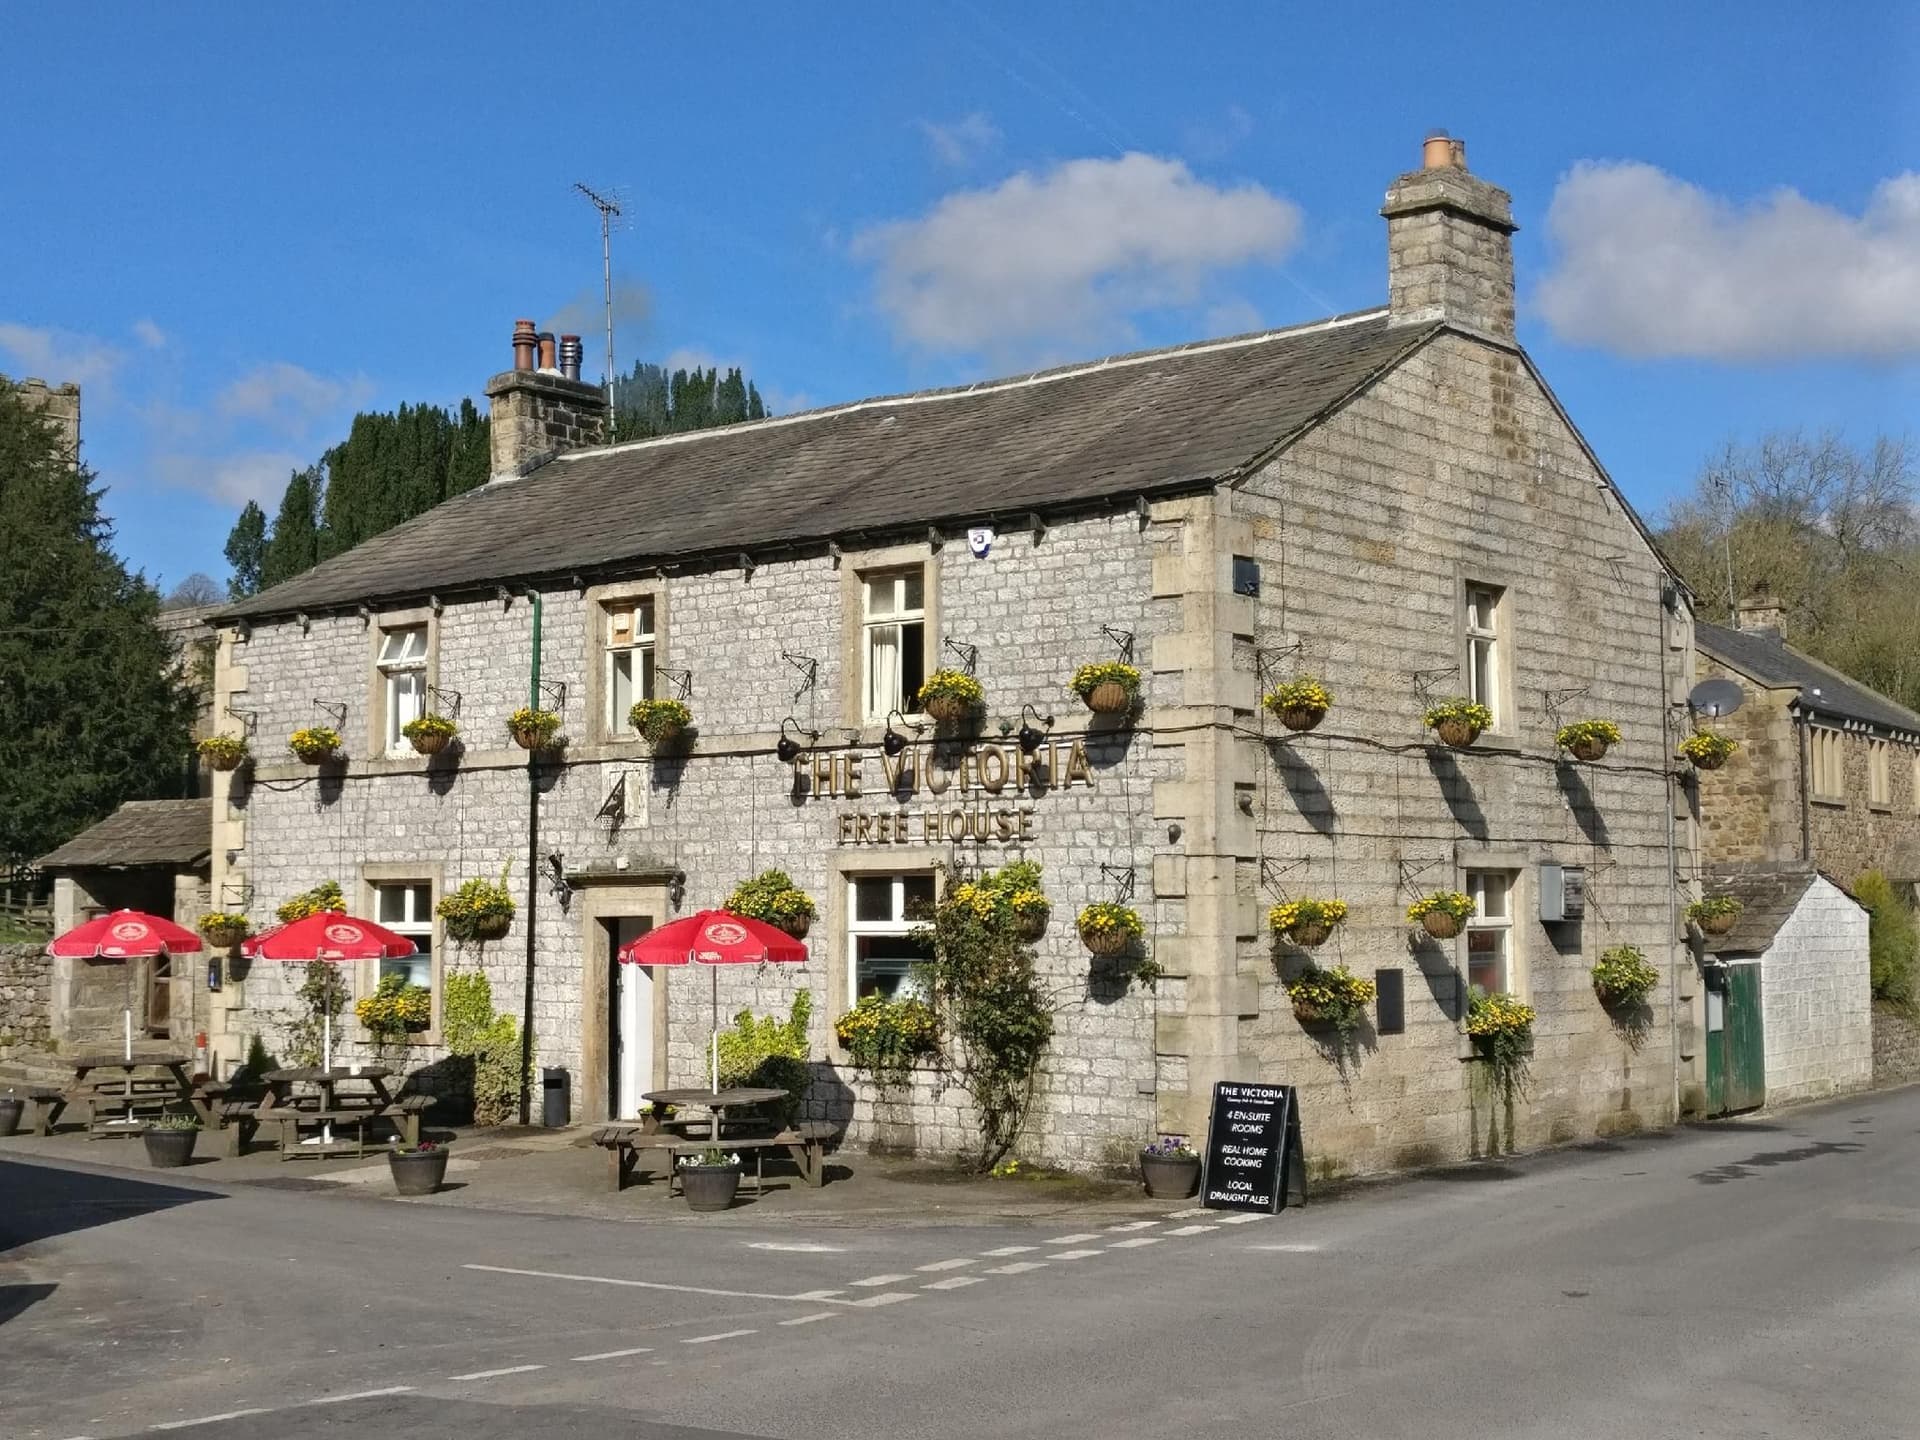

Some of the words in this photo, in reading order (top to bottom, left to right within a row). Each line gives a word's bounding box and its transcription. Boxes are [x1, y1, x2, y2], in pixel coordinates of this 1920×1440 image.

[794, 752, 862, 799] THE
[881, 740, 1095, 795] VICTORIA
[839, 810, 909, 846] FREE
[925, 807, 1034, 844] HOUSE
[1220, 1086, 1239, 1096] THE
[1241, 1087, 1284, 1099] VICTORIA
[1227, 1110, 1233, 1120] 4
[1234, 1112, 1271, 1122] EN-SUITE
[1231, 1123, 1264, 1135] ROOMS
[1222, 1144, 1241, 1154] REAL
[1242, 1146, 1269, 1156] HOME
[1224, 1157, 1262, 1168] COOKING
[1227, 1180, 1253, 1191] LOCAL
[1210, 1191, 1248, 1202] DRAUGHT
[1249, 1195, 1269, 1205] ALES
